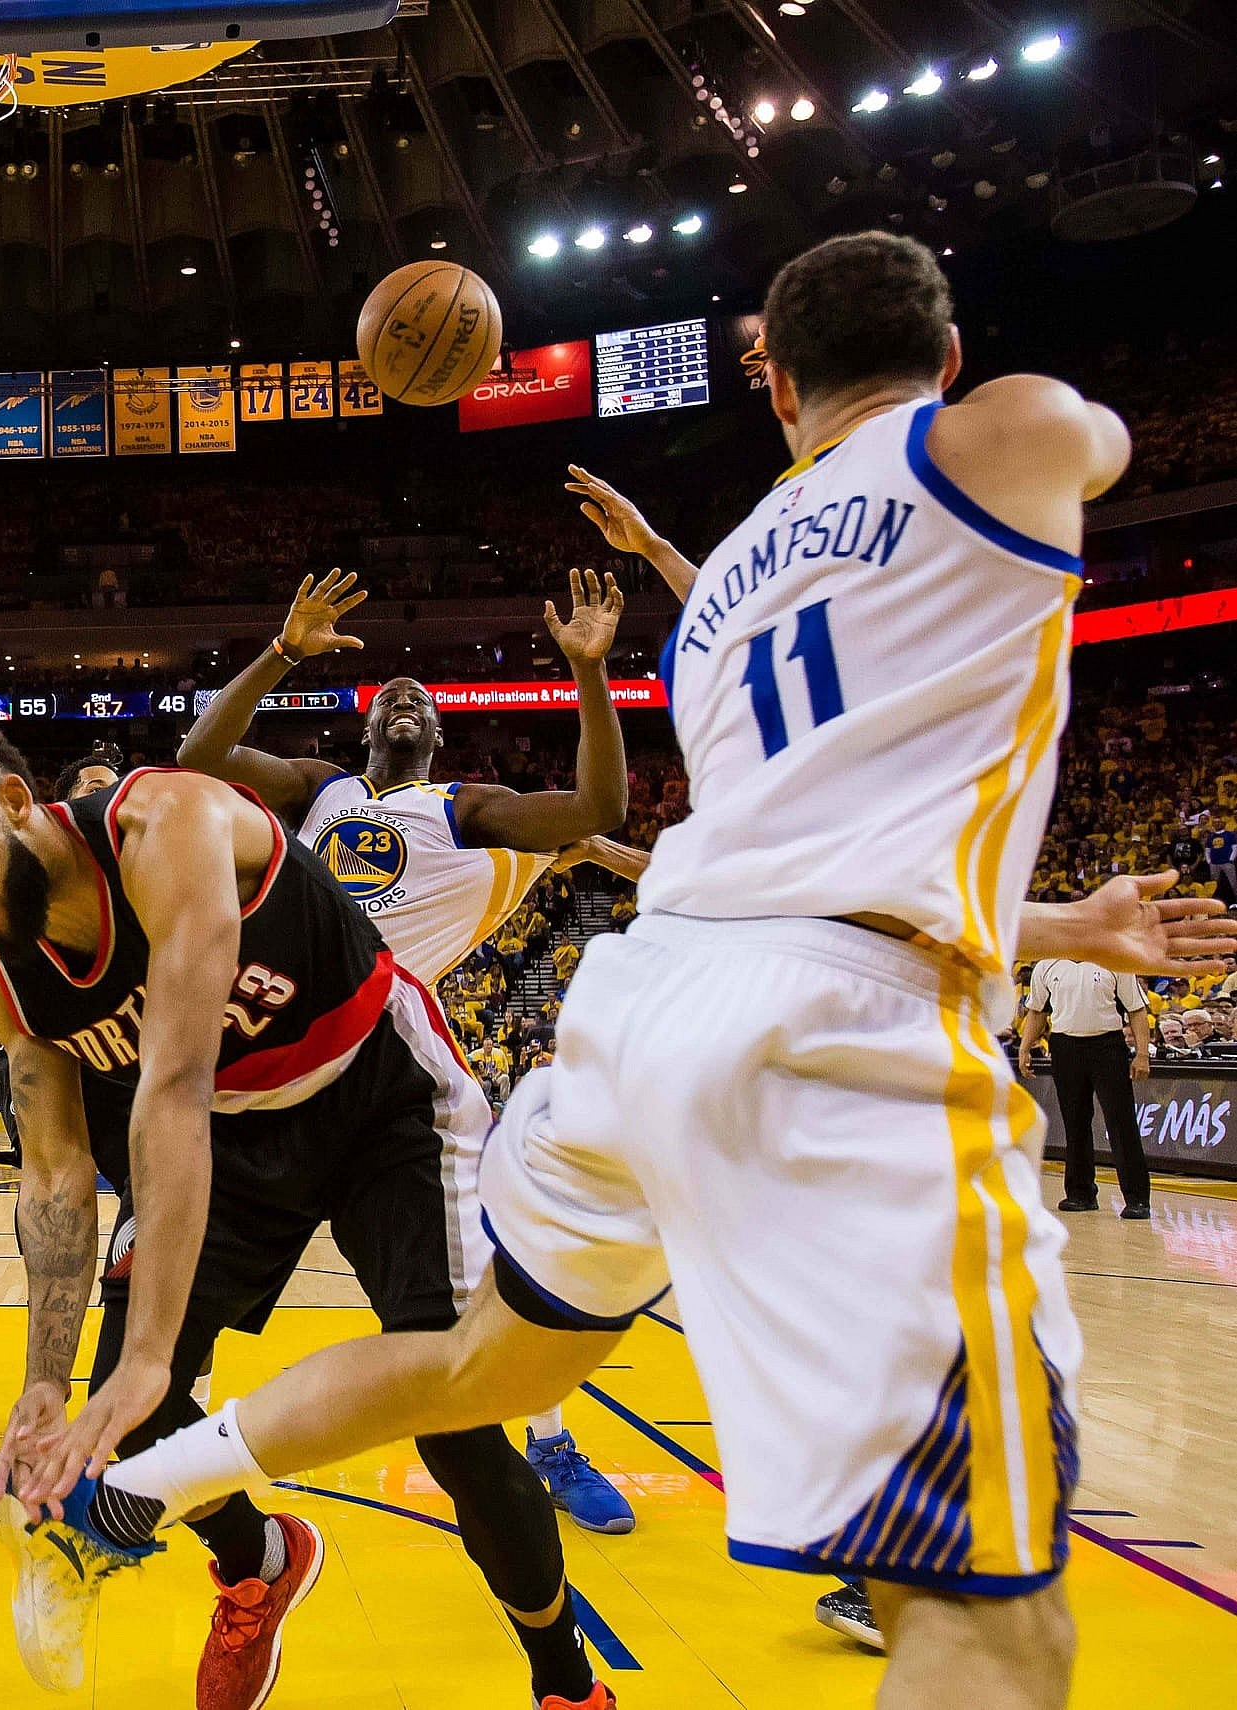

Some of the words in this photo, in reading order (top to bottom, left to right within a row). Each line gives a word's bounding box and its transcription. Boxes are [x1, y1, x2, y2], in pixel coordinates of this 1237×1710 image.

[473, 376, 570, 401] ORACLE
[749, 377, 772, 389] BA
[248, 385, 273, 413] 17
[294, 384, 329, 411] 24
[344, 382, 379, 408] 42
[57, 424, 102, 433] 1955-1956
[121, 421, 164, 430] 1974-1975
[184, 420, 229, 428] 2014-2015
[57, 445, 102, 453] CHAMPIONS
[185, 441, 230, 449] CHAMPIONS
[680, 496, 916, 655] THOMPSON
[739, 597, 844, 761] 11
[91, 693, 111, 702] 2nd
[158, 696, 185, 713] 46
[260, 698, 279, 707] TOL
[279, 697, 288, 706] 4
[308, 697, 320, 706] TF
[321, 696, 328, 705] 1
[435, 690, 467, 704] Cloud
[469, 689, 538, 706] Applications
[541, 688, 550, 702] &
[610, 689, 650, 702] ervices
[20, 699, 47, 715] 55
[82, 701, 123, 717] 13.7
[315, 807, 369, 834] GOLDEN
[373, 813, 411, 835] STATE
[356, 831, 392, 853] 23
[1158, 1093, 1231, 1147] MÁS
